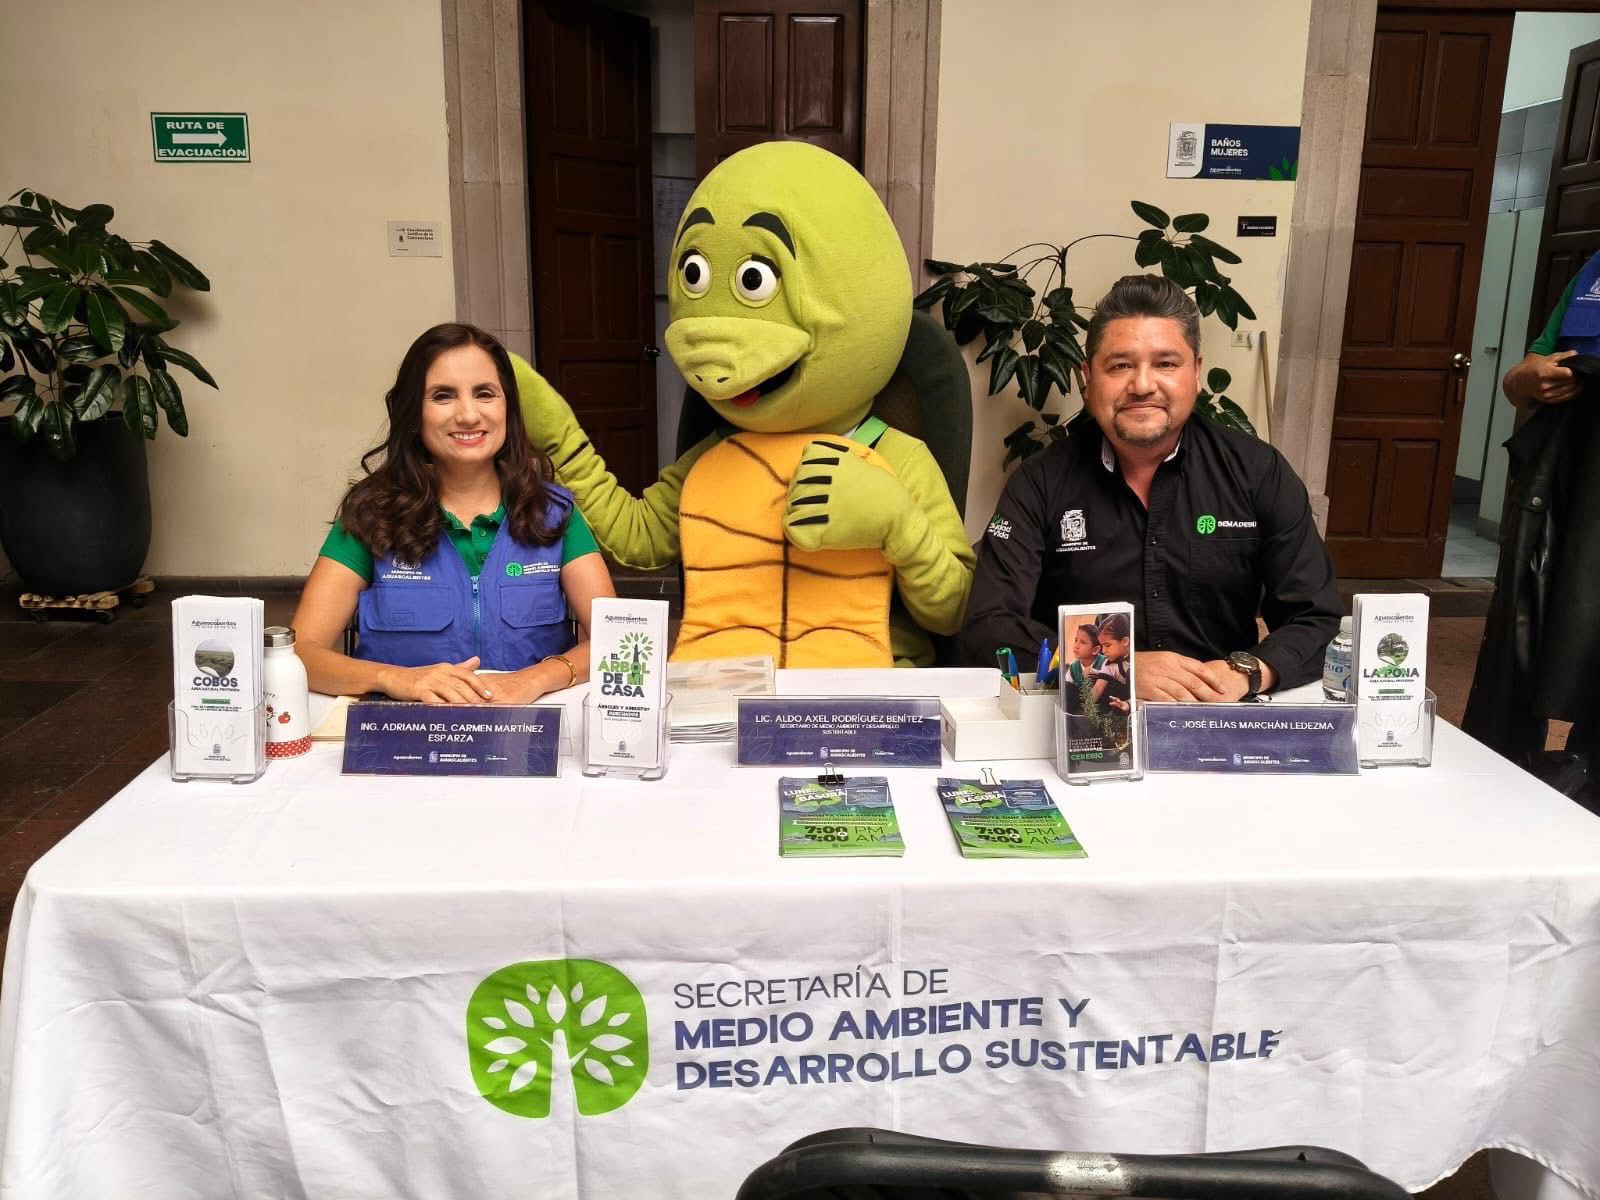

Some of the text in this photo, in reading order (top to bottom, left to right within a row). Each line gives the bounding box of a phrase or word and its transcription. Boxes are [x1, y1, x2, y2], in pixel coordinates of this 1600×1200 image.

[206, 122, 224, 130] DE
[1211, 138, 1241, 147] BAÑOS
[158, 148, 246, 156] EVACUACIÓN
[1210, 148, 1248, 156] MUJERES
[597, 656, 650, 674] ÁRBOL
[603, 672, 623, 684] DE
[1363, 668, 1420, 678] LA PONA
[193, 676, 238, 688] COBOS
[601, 684, 645, 698] CASA
[755, 712, 923, 723] LIC. ALDO AXEL RODRÍGUEZ BENÍTEZ
[360, 722, 544, 733] ING. ADRIANA DEL CARMEN MARTÍNEZ
[1169, 719, 1334, 730] C. JOSÉ ELÍAS MARCHÁN LEDEZMA
[428, 734, 474, 742] ESPARZA
[855, 826, 884, 834] PM
[1024, 828, 1056, 836] PM
[856, 834, 887, 842] AM
[1030, 836, 1059, 845] AM
[674, 964, 948, 1009] SECRETARÍA DE
[674, 997, 1090, 1050] MEDIO AMBIENTE Y
[676, 1030, 1283, 1091] DESARROLLO SUSTENTABLE
